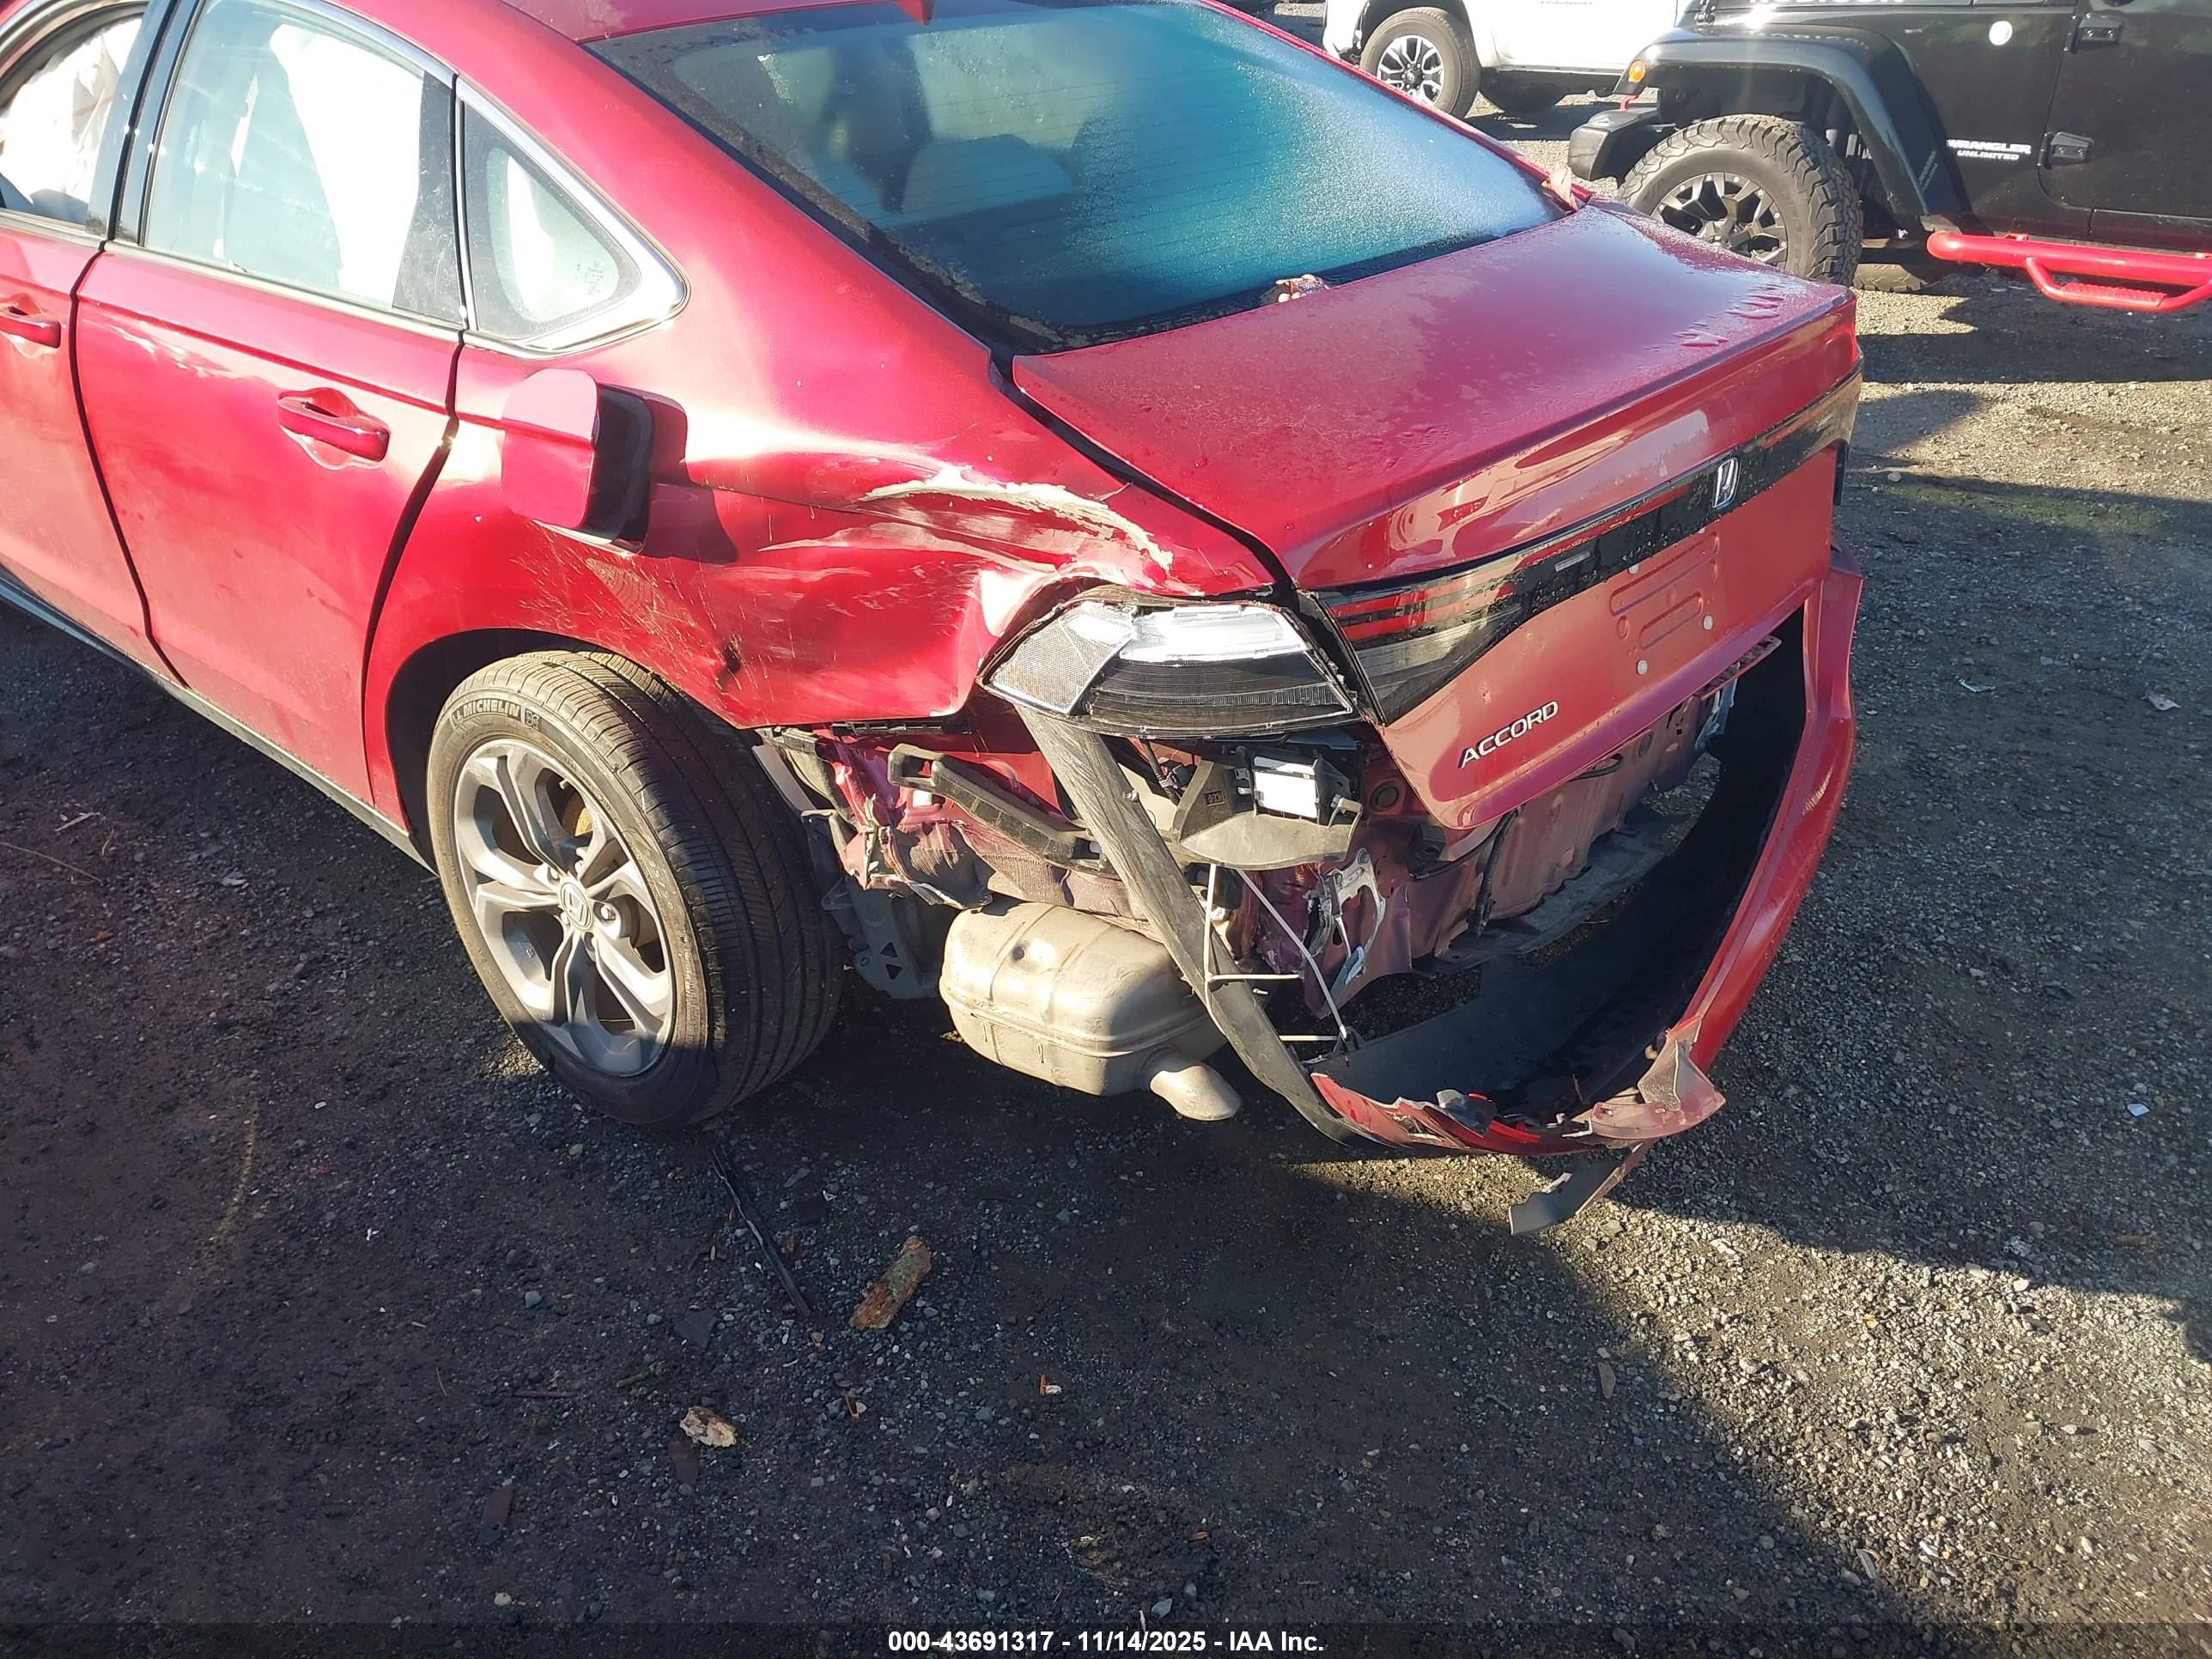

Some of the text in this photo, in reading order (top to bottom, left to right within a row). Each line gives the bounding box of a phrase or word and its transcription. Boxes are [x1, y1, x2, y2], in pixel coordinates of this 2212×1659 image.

[1946, 139, 2032, 155] WRANGLER
[1957, 149, 2020, 161] UNLIMITED
[463, 698, 521, 720] MICHELIN
[1459, 701, 1558, 769] ACCORD
